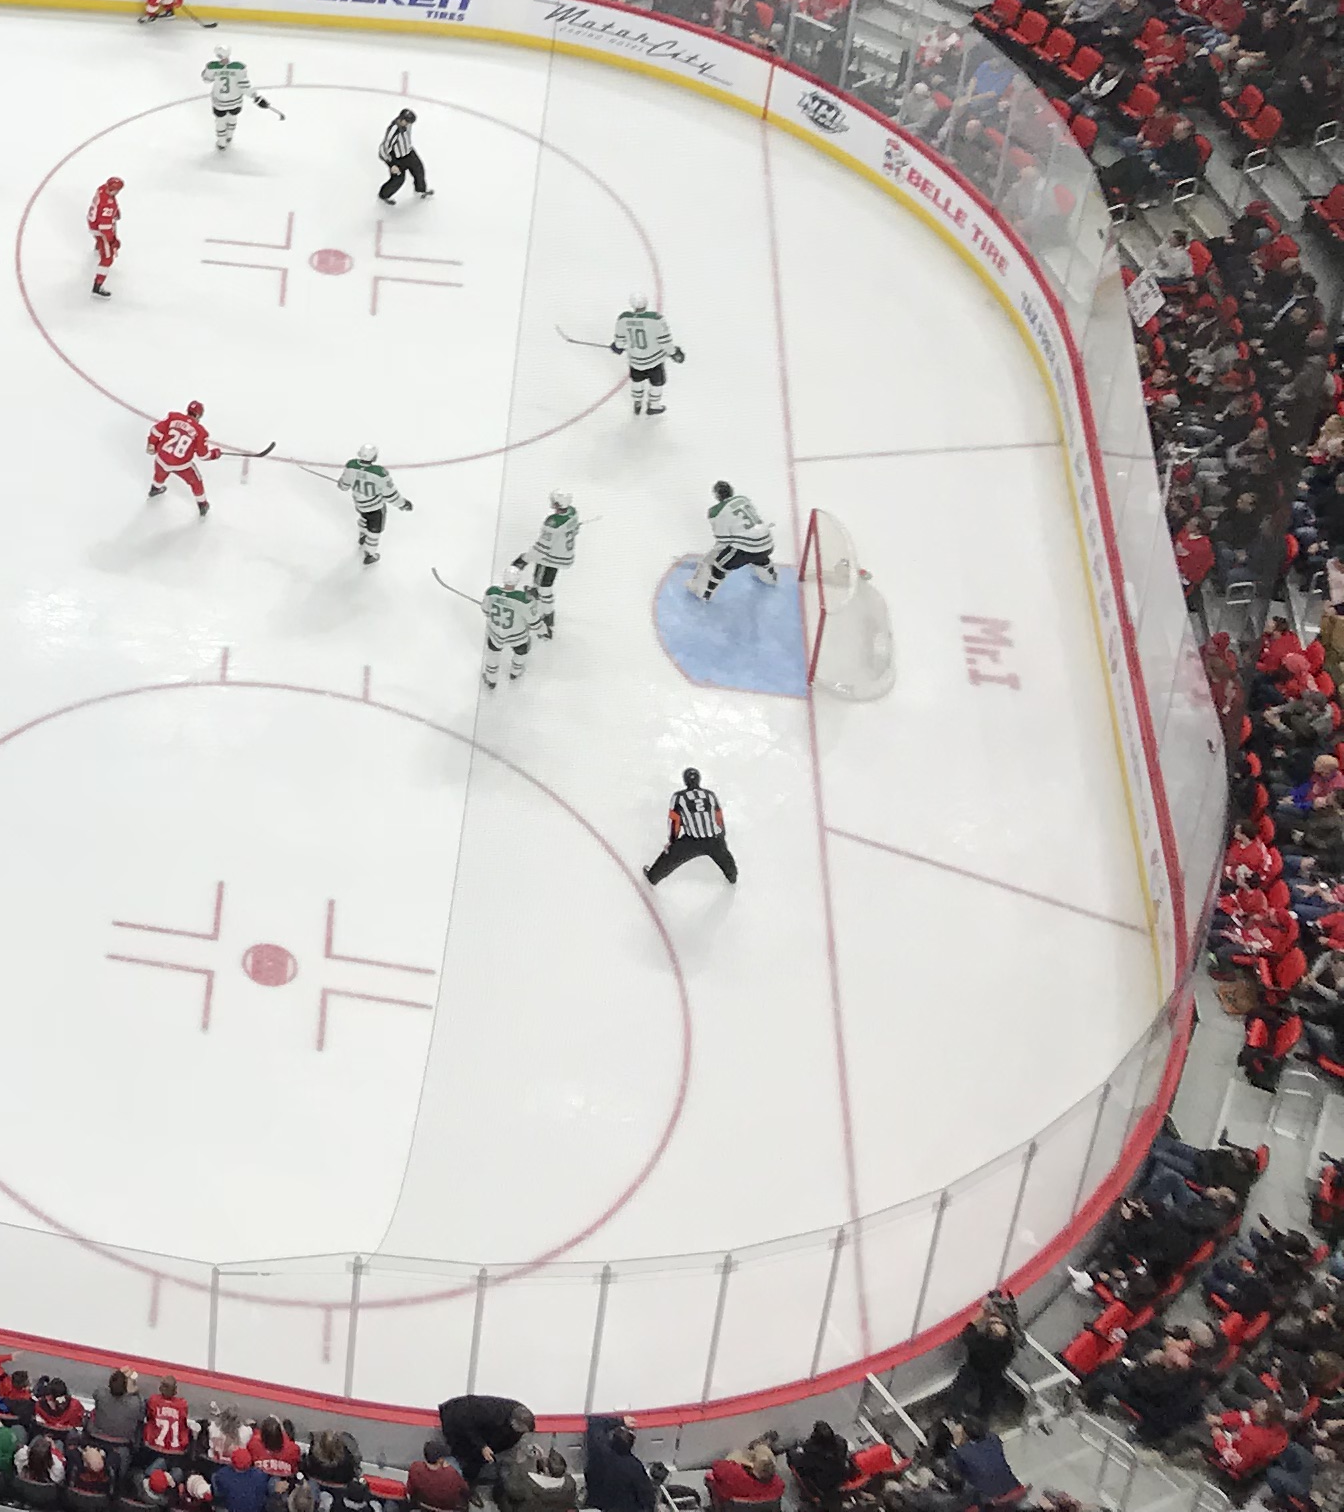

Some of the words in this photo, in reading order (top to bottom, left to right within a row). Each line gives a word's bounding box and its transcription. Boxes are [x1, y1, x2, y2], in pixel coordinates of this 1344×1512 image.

[426, 10, 465, 21] TIRES
[220, 77, 230, 94] 3
[906, 166, 968, 229] BELLE
[971, 222, 1010, 276] TIRE
[627, 328, 647, 350] 10
[162, 428, 193, 459] 28
[490, 603, 515, 630] 23
[155, 1418, 180, 1448] 71
